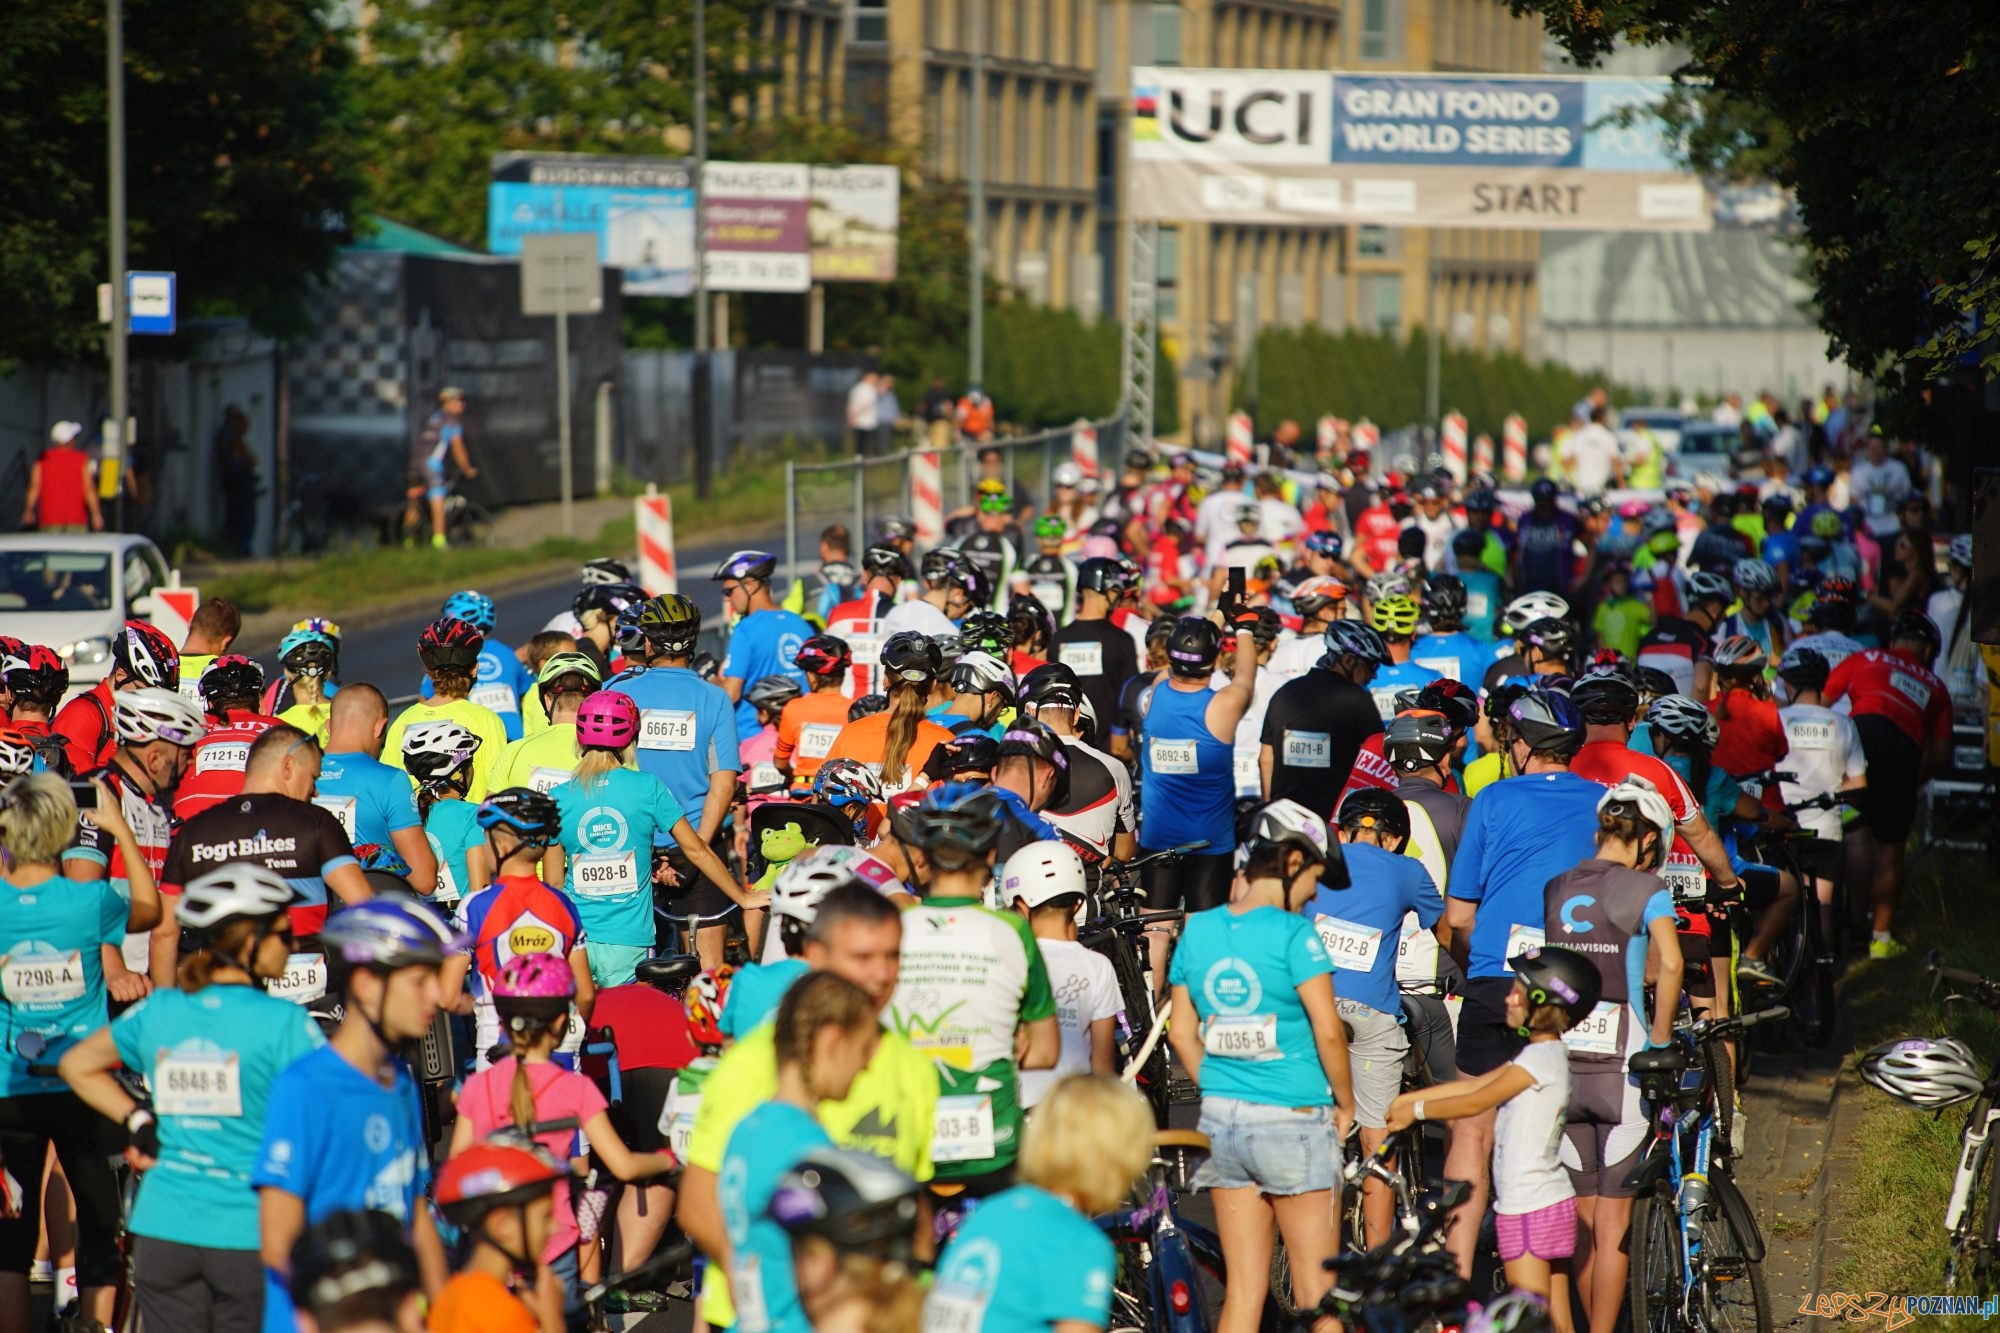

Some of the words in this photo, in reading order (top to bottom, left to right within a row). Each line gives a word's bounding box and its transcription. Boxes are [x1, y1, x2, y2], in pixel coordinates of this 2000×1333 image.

[1346, 89, 1439, 119] GRAN
[1443, 91, 1560, 121] FONDO
[1170, 89, 1313, 145] UCI
[1342, 123, 1461, 153] WORLD
[1465, 125, 1573, 156] SERIES
[1472, 182, 1584, 214] START
[647, 721, 688, 737] 6667-B
[808, 733, 833, 747] 7157
[1289, 741, 1323, 755] 6871-B
[204, 750, 247, 761] 7121-B
[1156, 749, 1190, 763] 6892-B
[192, 840, 238, 863] Fogt
[238, 836, 296, 856] Bikes
[265, 857, 297, 869] Team
[582, 865, 628, 882] 6928-B
[1664, 875, 1701, 890] 6839-B
[513, 935, 547, 947] Mróz
[1321, 931, 1368, 956] 6912-B
[13, 967, 73, 988] 7298-A
[1217, 1031, 1266, 1050] 7036-B
[935, 1117, 980, 1138] 03-B
